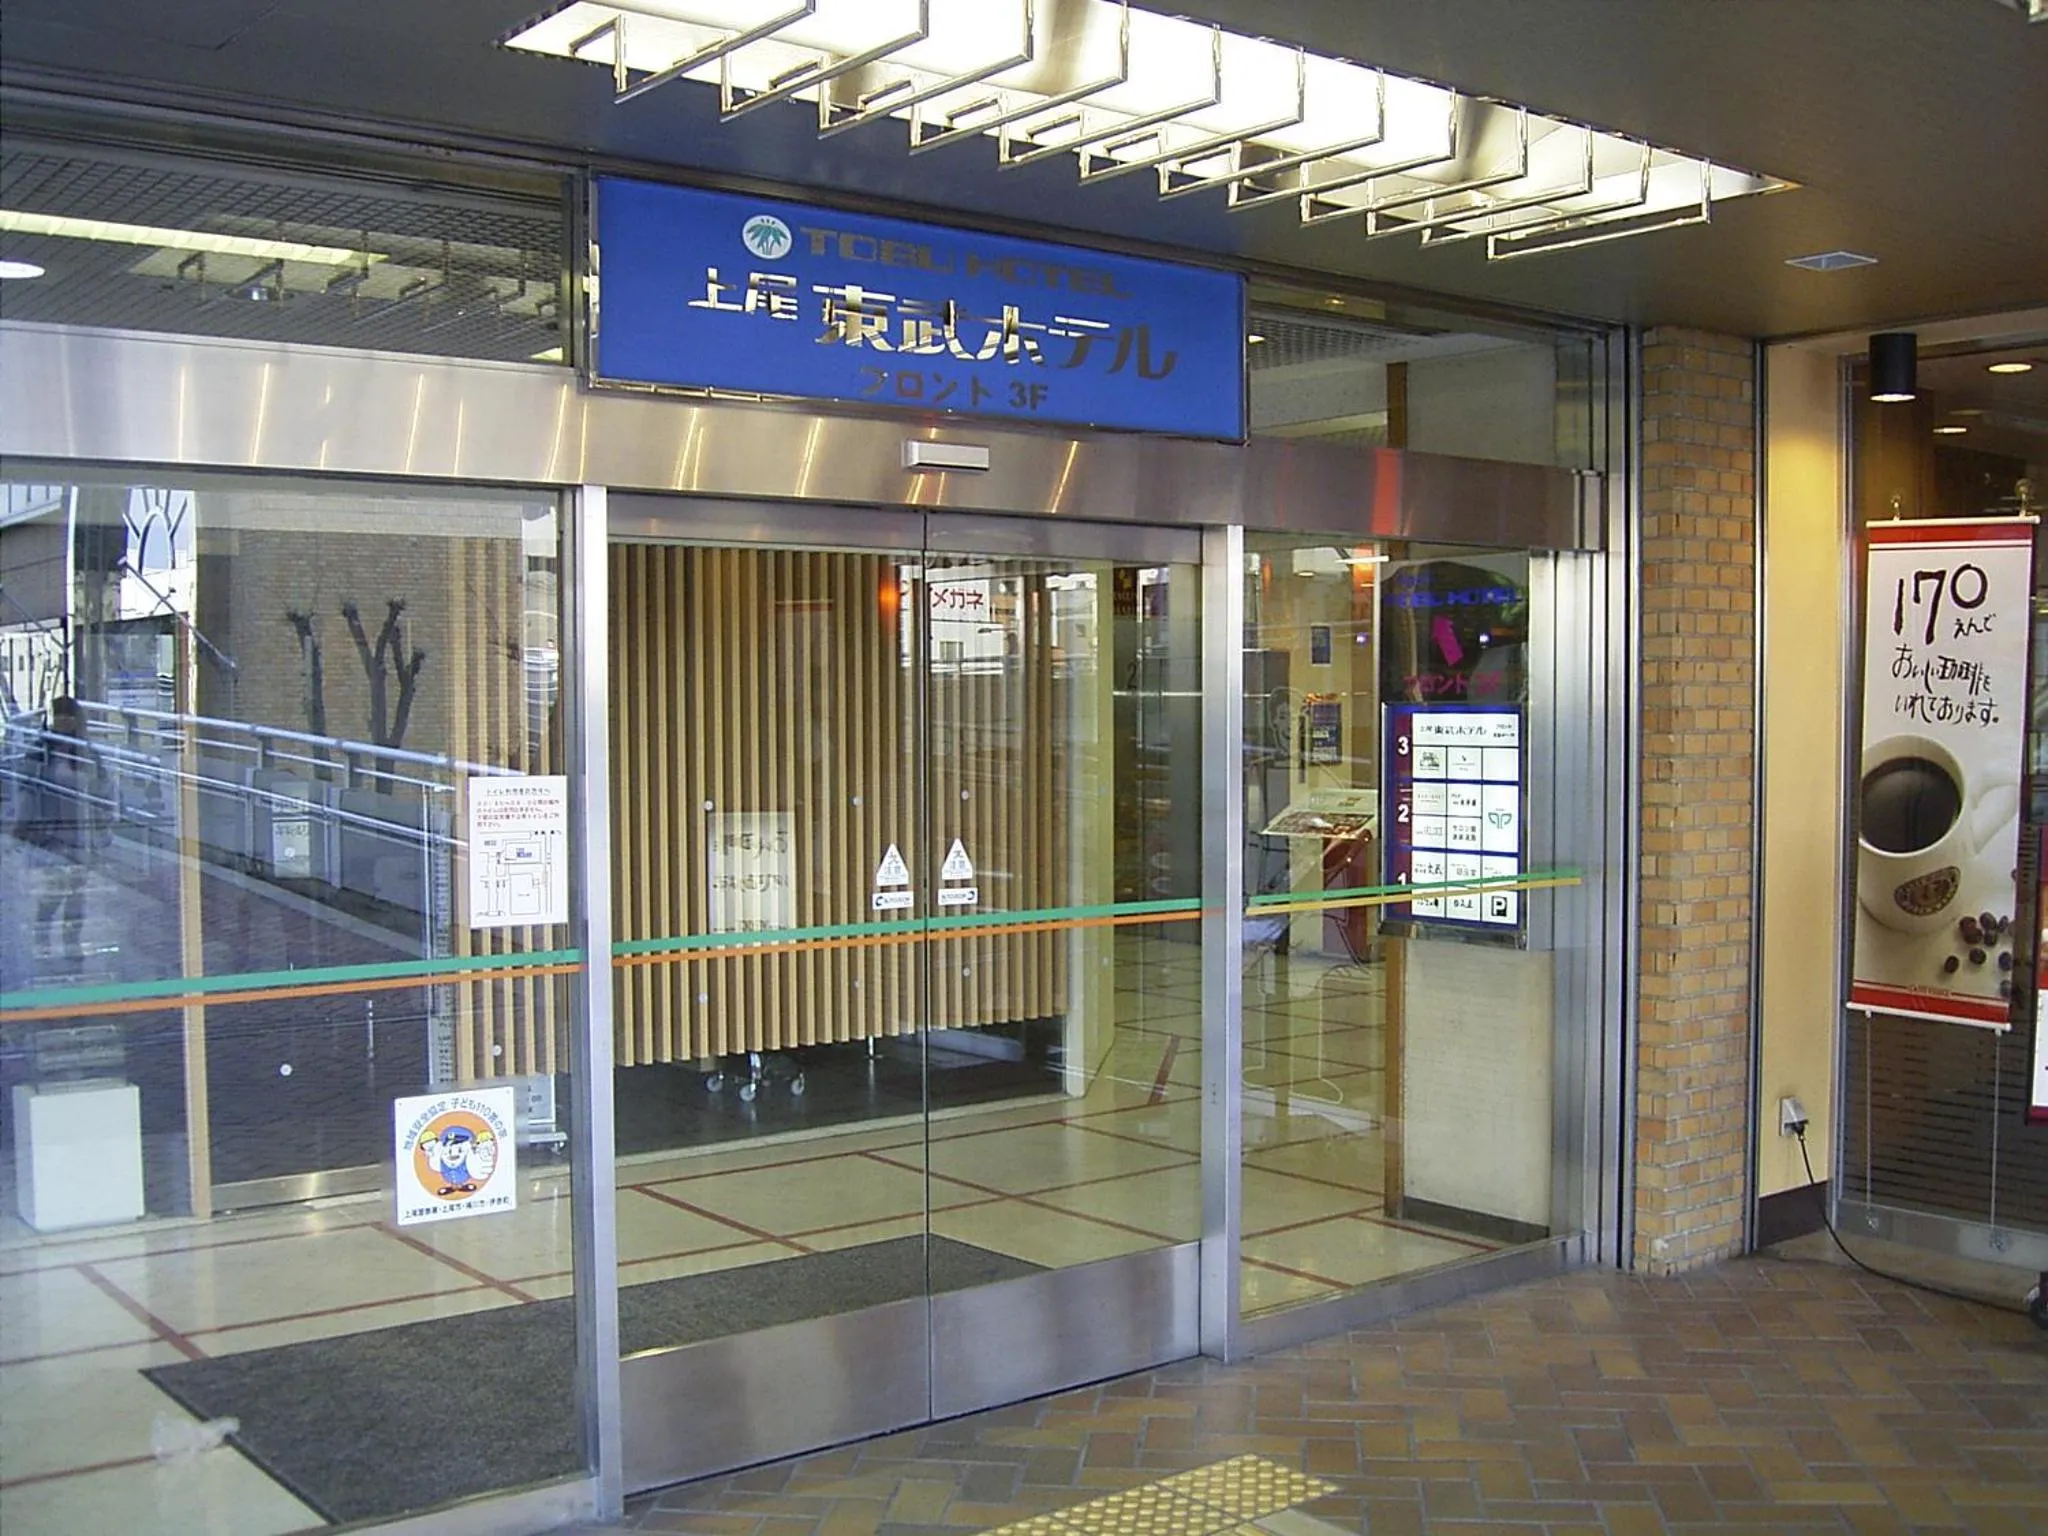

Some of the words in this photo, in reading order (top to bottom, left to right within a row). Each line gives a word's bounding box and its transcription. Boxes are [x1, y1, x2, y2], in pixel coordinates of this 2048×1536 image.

[801, 225, 953, 275] TOBU
[964, 254, 1134, 300] HOTEL
[687, 266, 1178, 382] 上尾東武ホテル
[860, 364, 993, 407] フロント
[1008, 379, 1049, 412] 3F
[931, 586, 985, 610] メガネ
[1892, 562, 1989, 646] 170
[1953, 613, 1997, 640] えんで
[1894, 692, 2000, 728] いれております。
[1398, 736, 1409, 756] 3
[1397, 803, 1409, 823] 2
[1491, 896, 1508, 917] P
